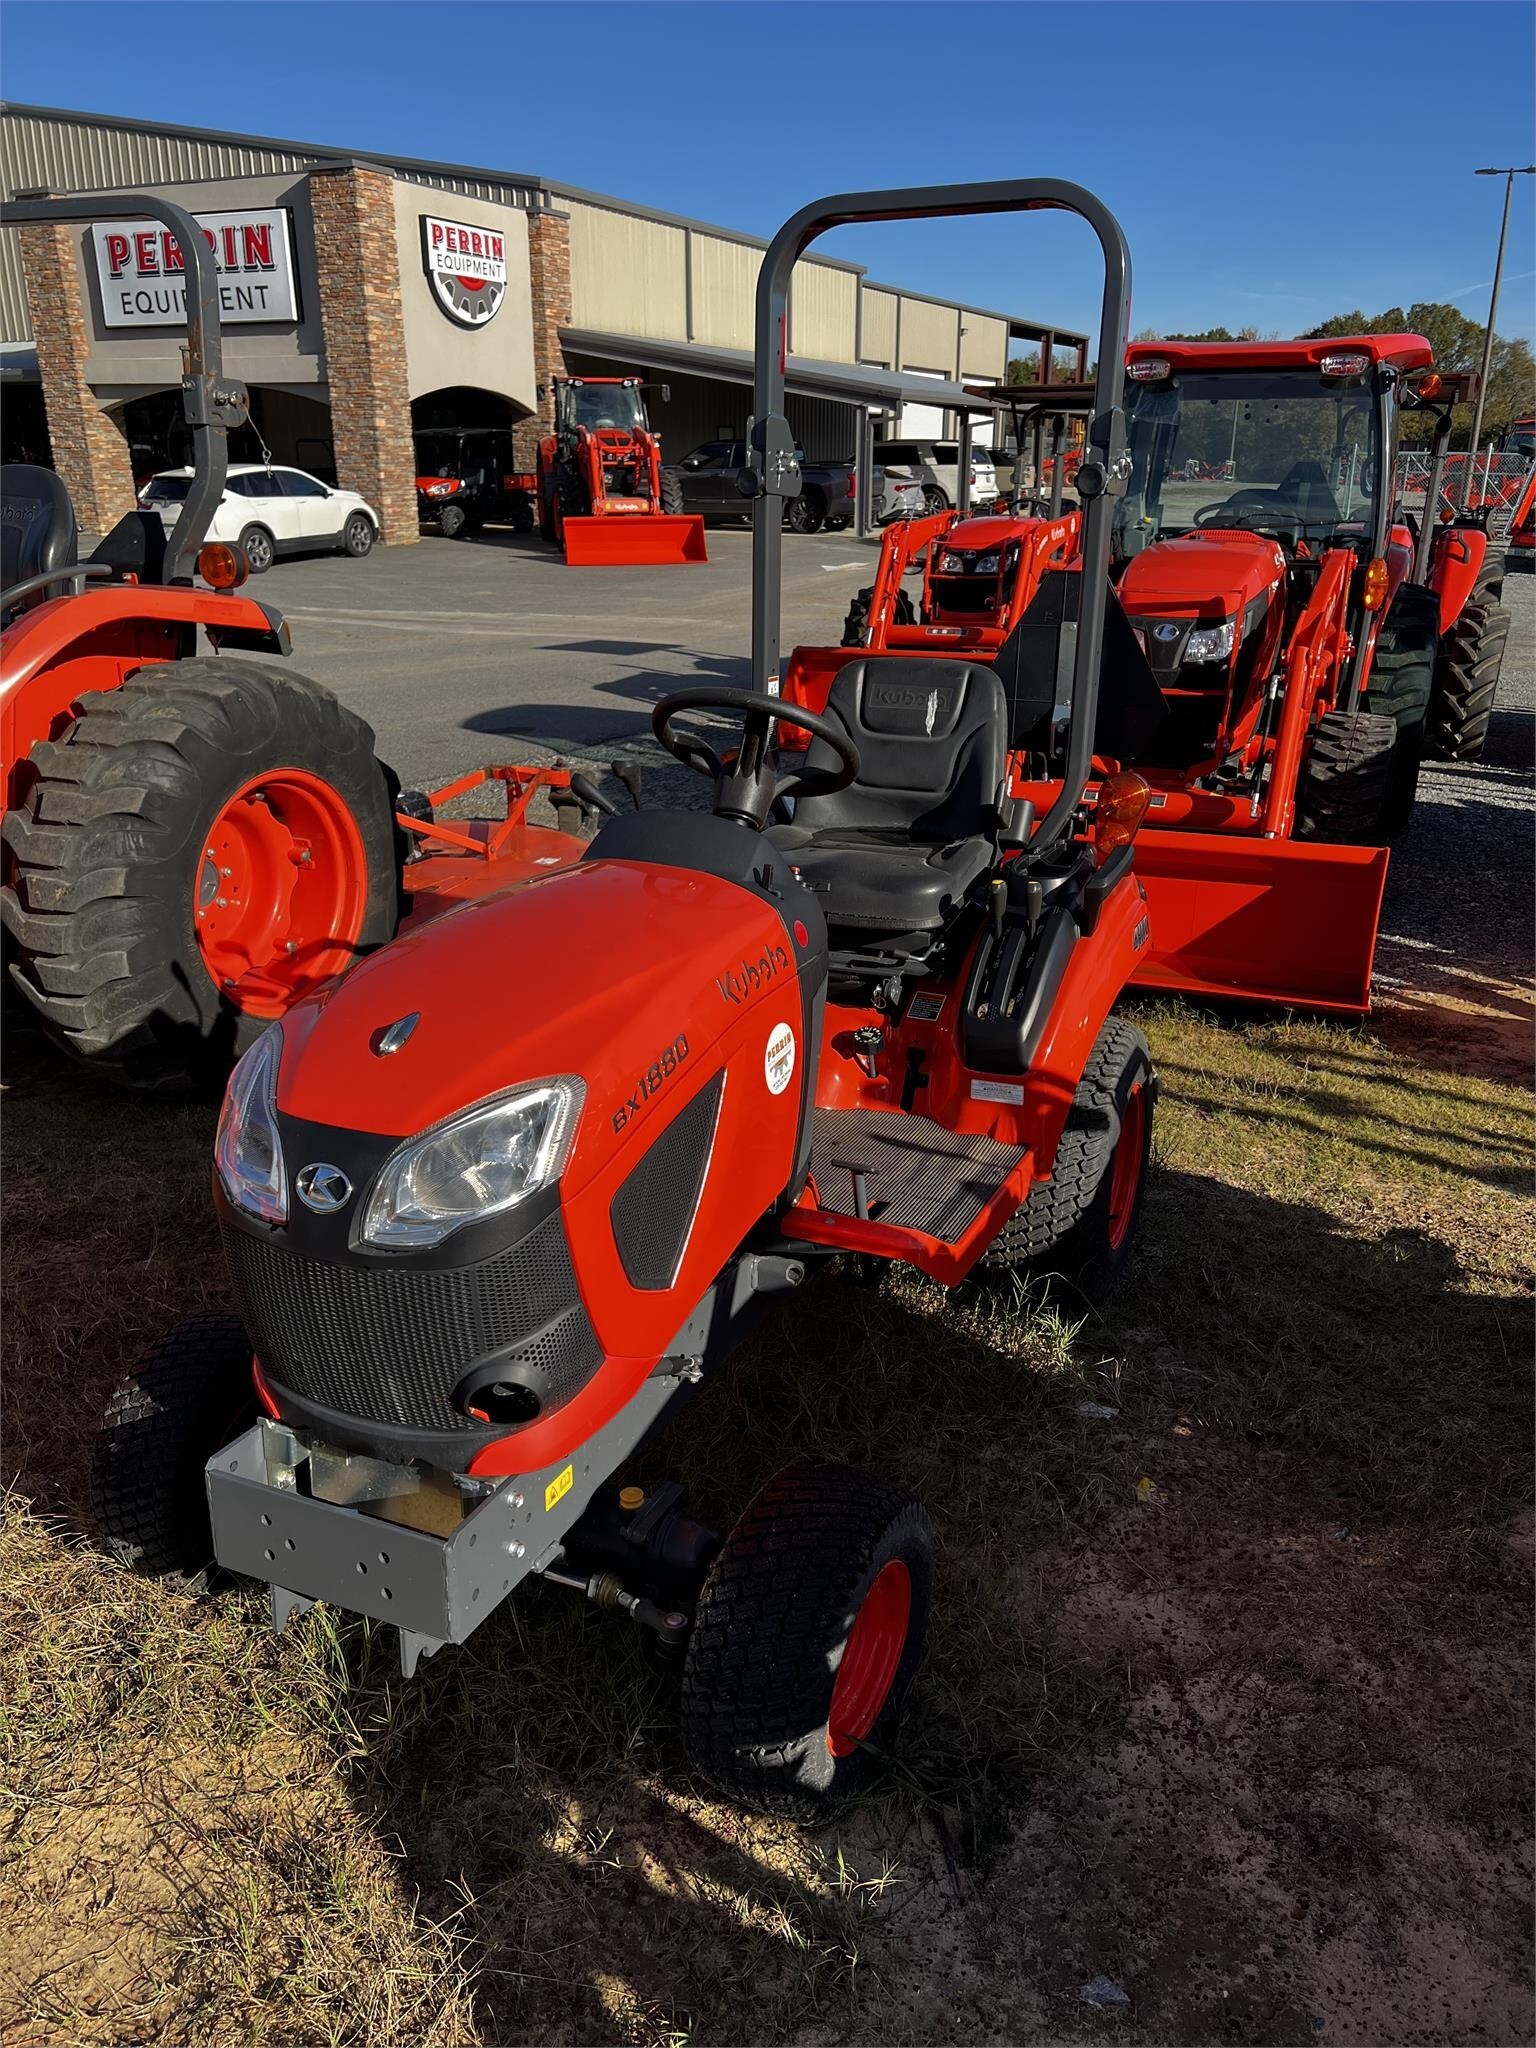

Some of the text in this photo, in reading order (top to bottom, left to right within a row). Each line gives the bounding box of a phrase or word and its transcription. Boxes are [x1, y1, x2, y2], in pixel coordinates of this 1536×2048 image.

[431, 223, 504, 262] PERRIN
[436, 253, 502, 279] EQUIPMENT
[121, 285, 269, 315] EQUIENT
[716, 944, 789, 1005] Kubota
[611, 1033, 689, 1134] BX1880
